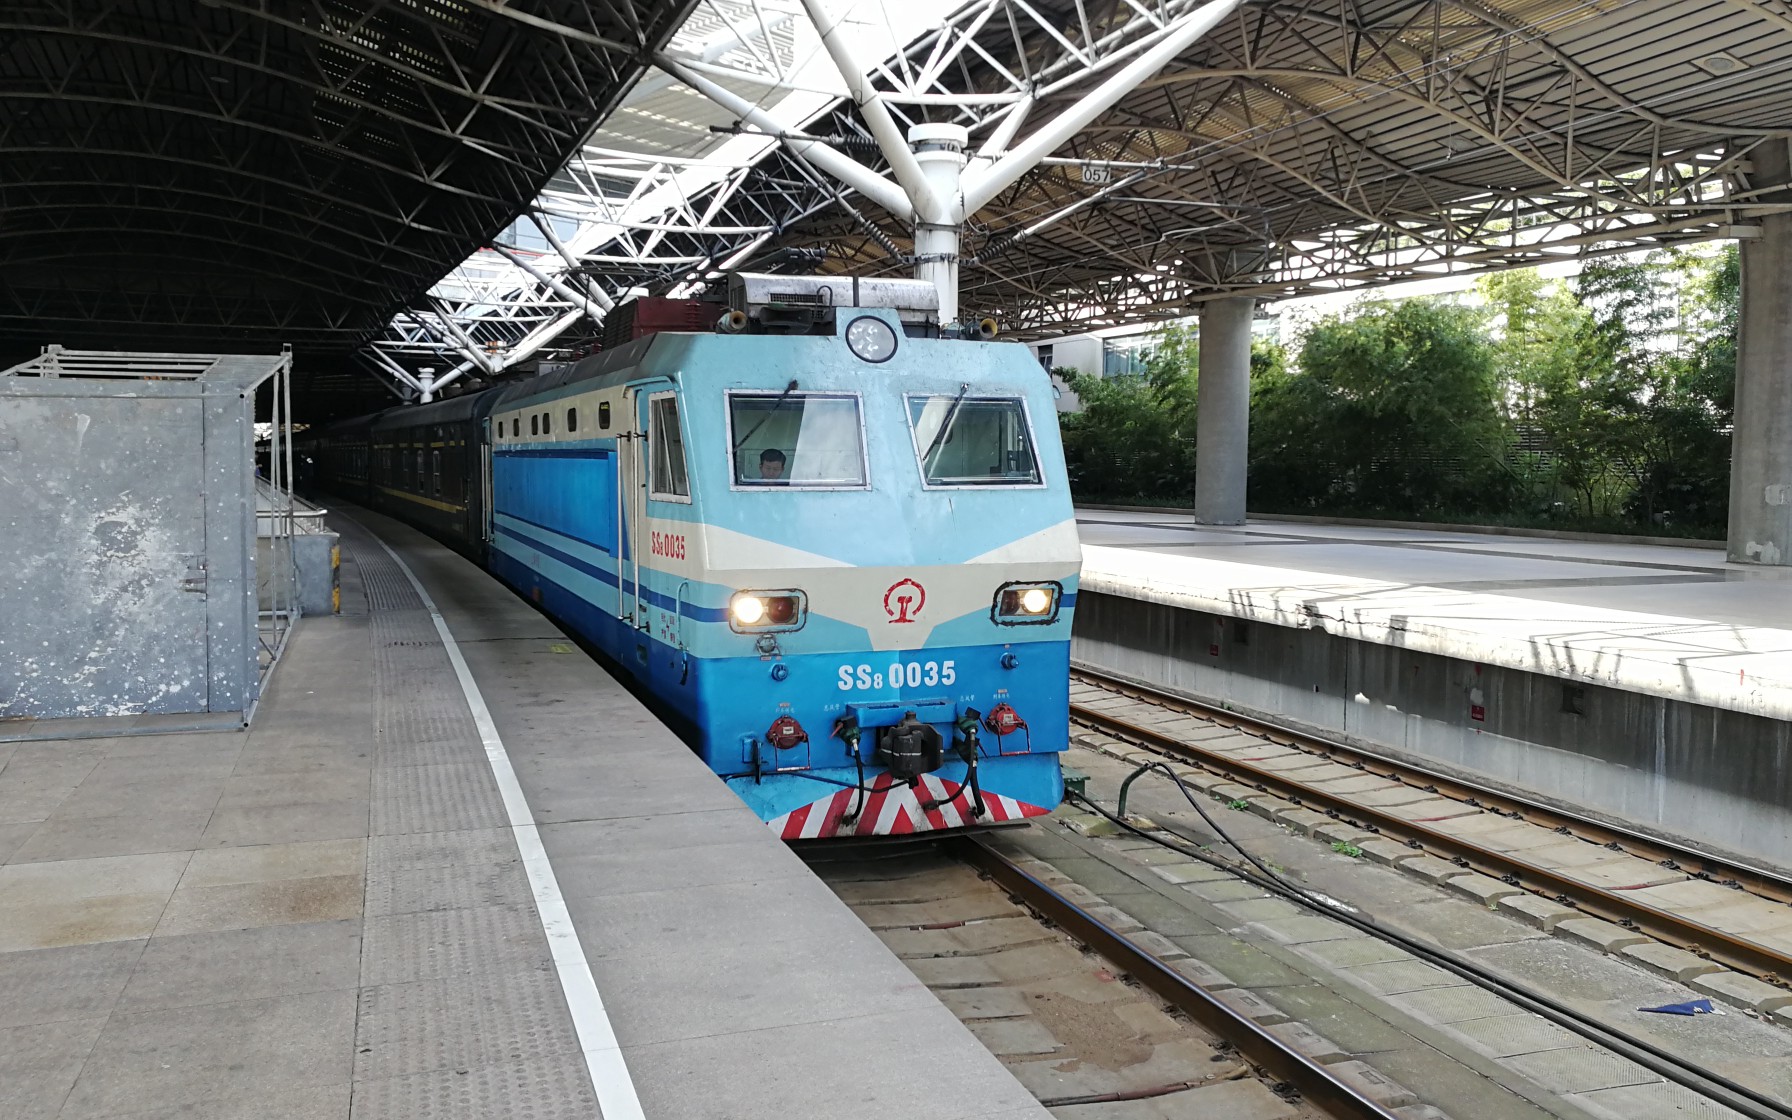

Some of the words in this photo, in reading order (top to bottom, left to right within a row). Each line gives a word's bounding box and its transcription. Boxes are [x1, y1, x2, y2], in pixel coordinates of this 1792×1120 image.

[1084, 169, 1110, 182] 057
[664, 533, 686, 561] 0035
[837, 664, 883, 691] SS8
[888, 660, 956, 689] 0035
